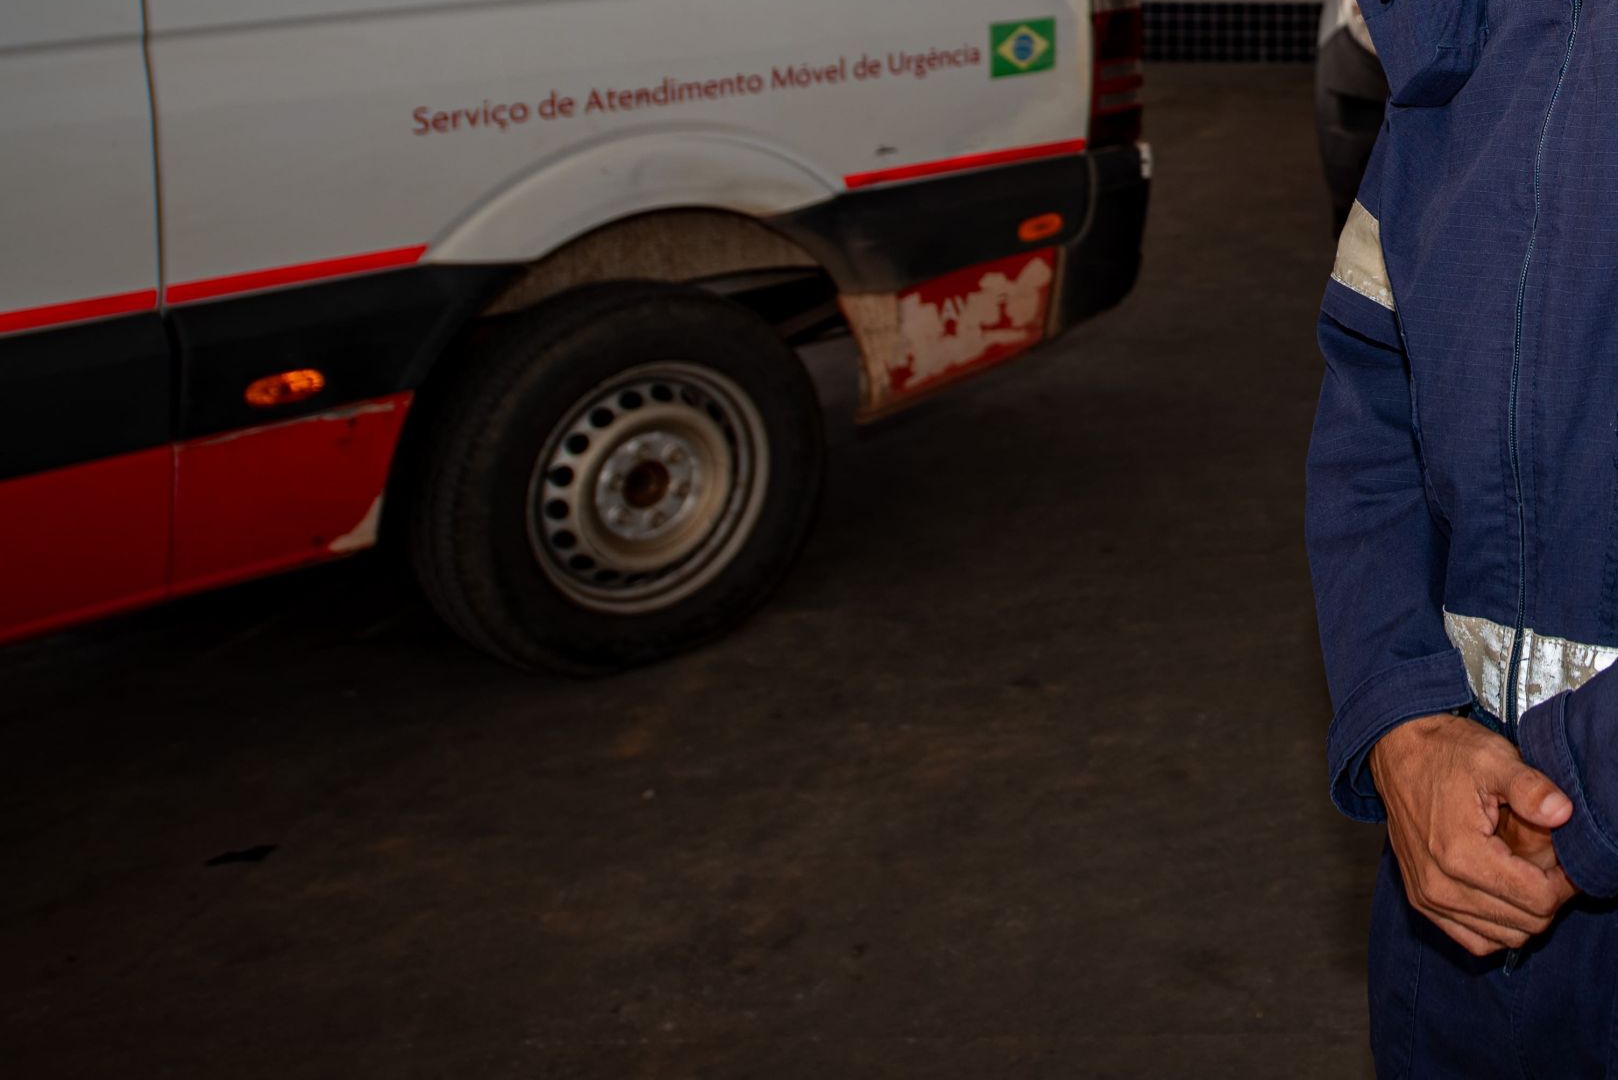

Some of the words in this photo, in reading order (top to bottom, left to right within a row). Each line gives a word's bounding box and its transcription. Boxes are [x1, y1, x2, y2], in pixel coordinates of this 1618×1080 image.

[412, 96, 529, 135] Serviço
[538, 90, 577, 119] de
[585, 71, 764, 114] Atendimento
[771, 52, 848, 89] Móvel
[853, 54, 883, 78] de
[888, 43, 982, 78] Urgência
